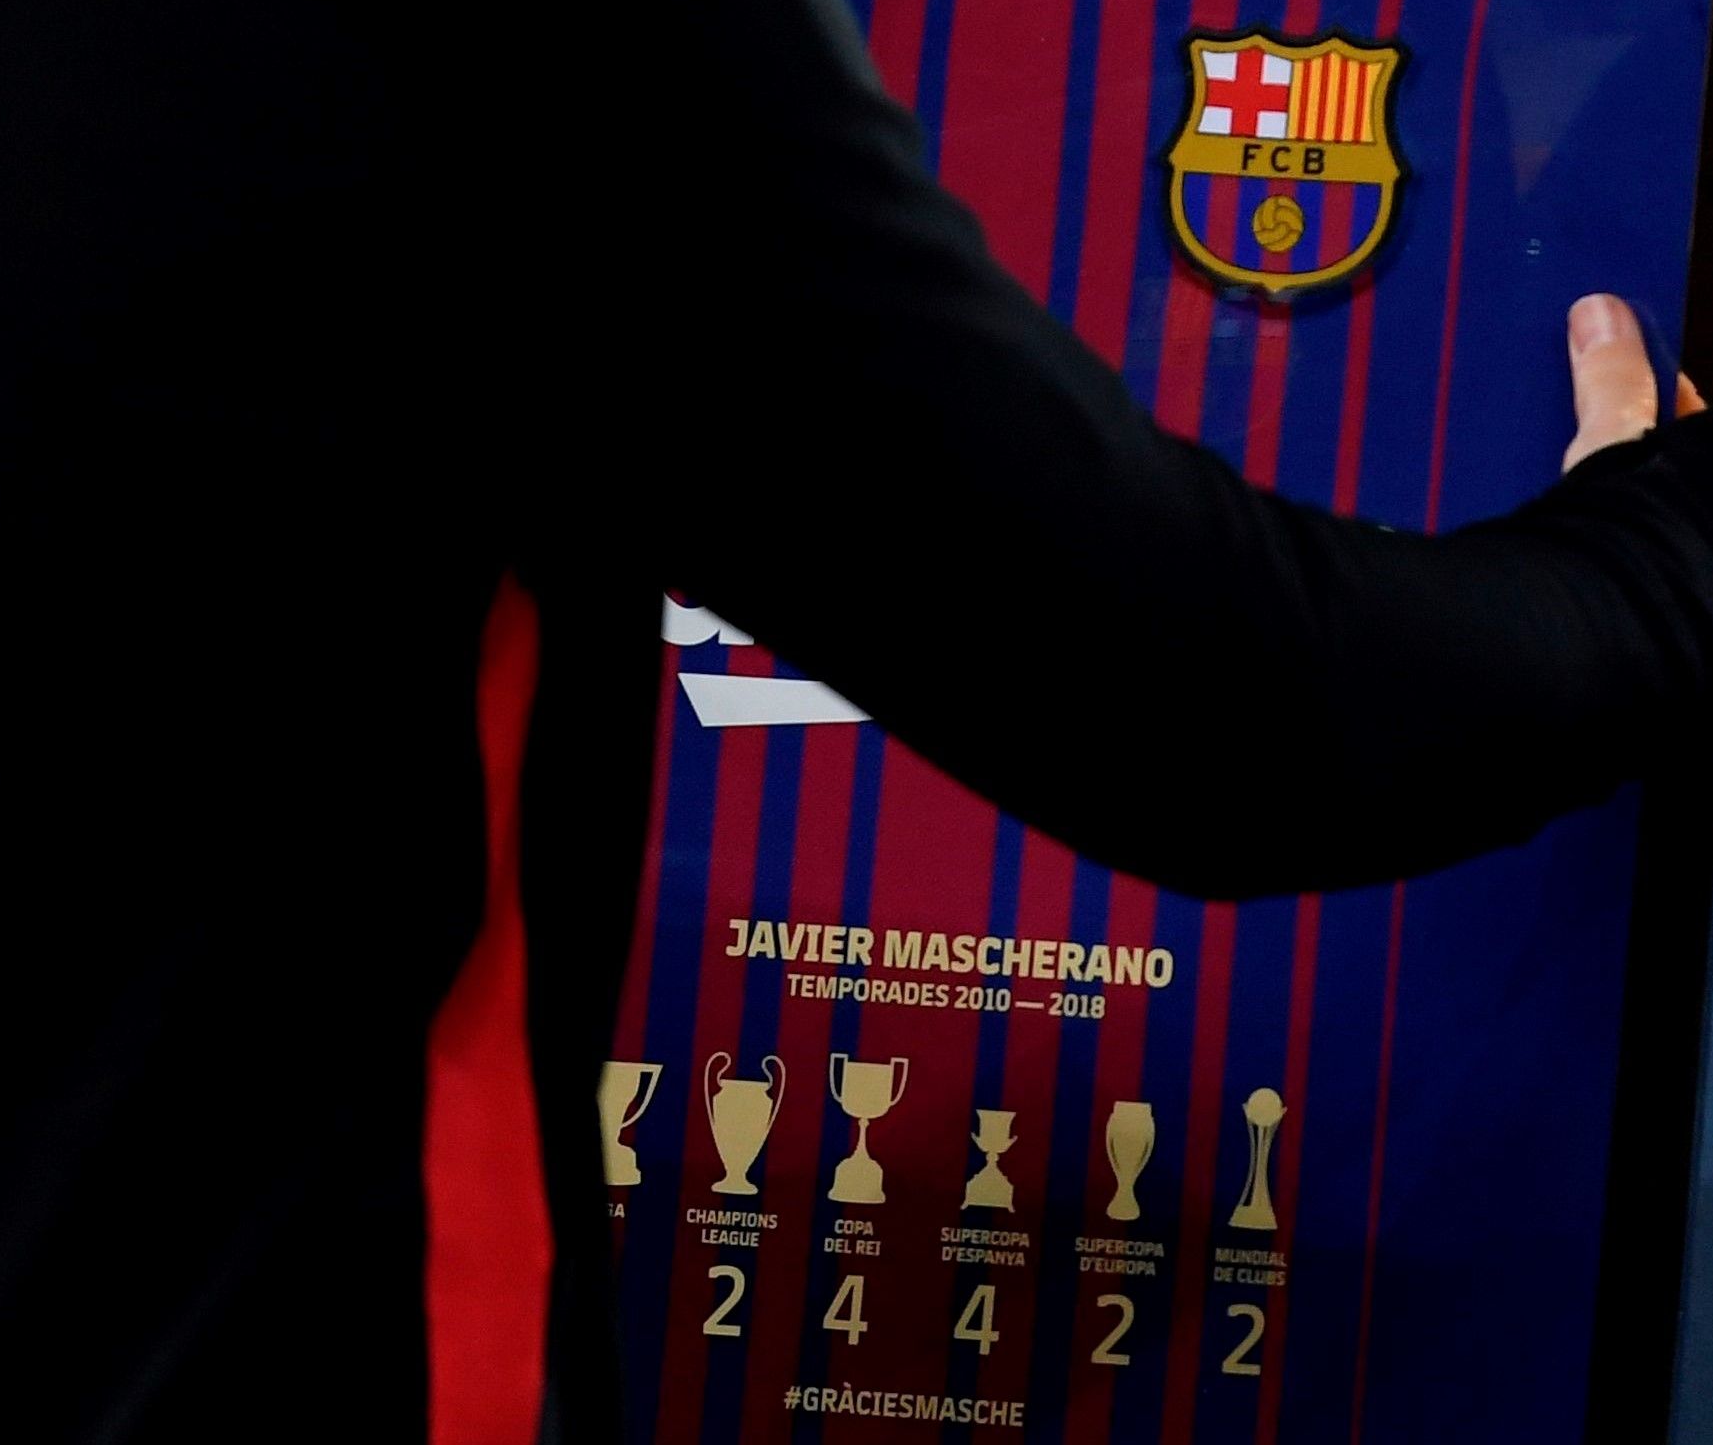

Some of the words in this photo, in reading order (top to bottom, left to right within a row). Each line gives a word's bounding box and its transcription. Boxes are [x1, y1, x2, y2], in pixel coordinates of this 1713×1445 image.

[725, 918, 875, 966] JAVIER
[883, 929, 1174, 988] MASCHERANO
[787, 973, 949, 1008] TEMPORADES
[953, 985, 1011, 1012] 2010
[1049, 992, 1106, 1019] 2018
[686, 1208, 778, 1230] CHAMPIONS
[834, 1218, 875, 1237] COPA
[701, 1228, 760, 1248] LEAGUE
[823, 1237, 853, 1255] DEL
[855, 1239, 882, 1257] REI
[940, 1226, 1031, 1249] SUPERCOPA
[1074, 1236, 1165, 1258] SUPERCOPA
[941, 1246, 1026, 1267] D'ESPANYA
[1079, 1256, 1156, 1276] D'EUROPA
[1214, 1247, 1288, 1267] MUNDIAL
[1213, 1266, 1235, 1283] DE
[1238, 1267, 1287, 1287] CLUBS
[702, 1264, 746, 1337] 2
[822, 1274, 868, 1346] 4
[953, 1284, 1000, 1356] 4
[1091, 1293, 1135, 1366] 2
[1221, 1303, 1266, 1376] 2
[783, 1381, 1025, 1427] #GRÀCIESMASCHE
